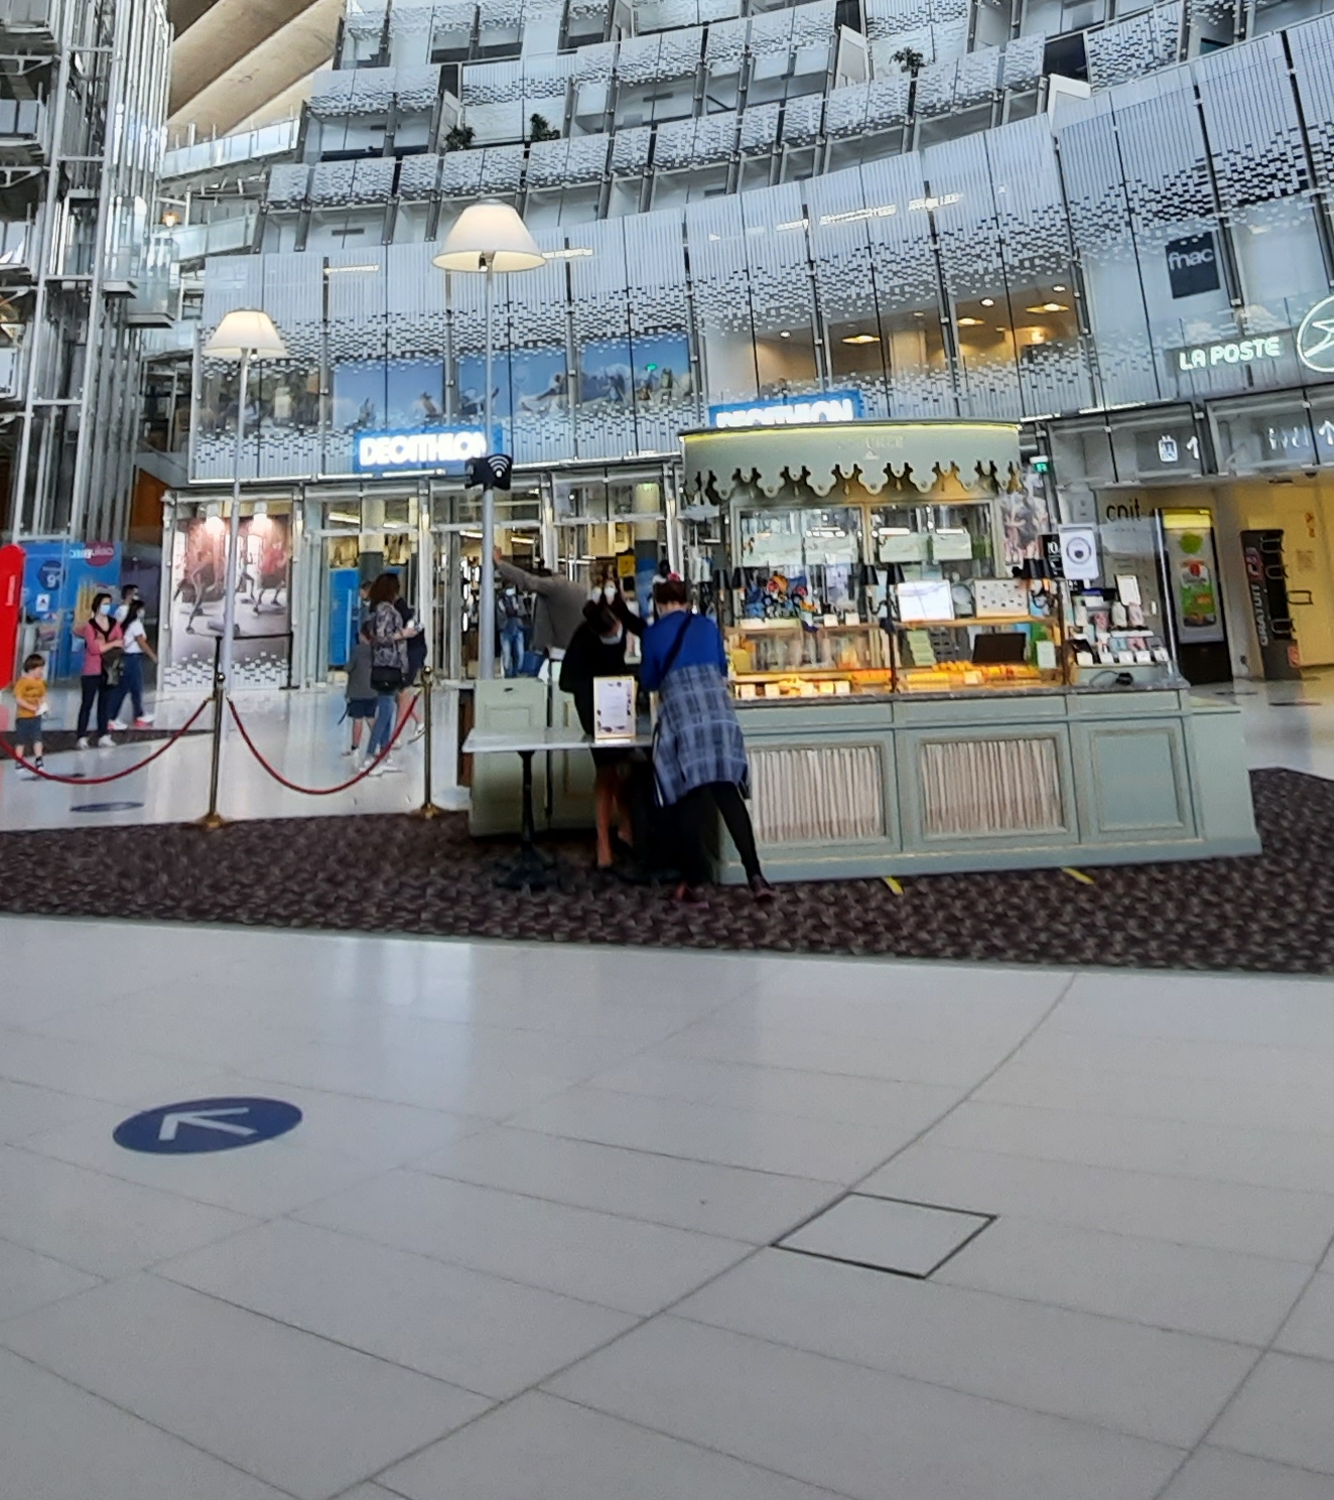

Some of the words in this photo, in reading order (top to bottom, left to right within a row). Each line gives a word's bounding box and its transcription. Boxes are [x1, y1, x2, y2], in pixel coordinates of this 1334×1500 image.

[1168, 247, 1215, 270] fnac
[1178, 350, 1207, 371] LA
[1210, 335, 1281, 366] POSTE
[1105, 498, 1142, 522] cnit
[1252, 584, 1268, 646] GRATUIT
